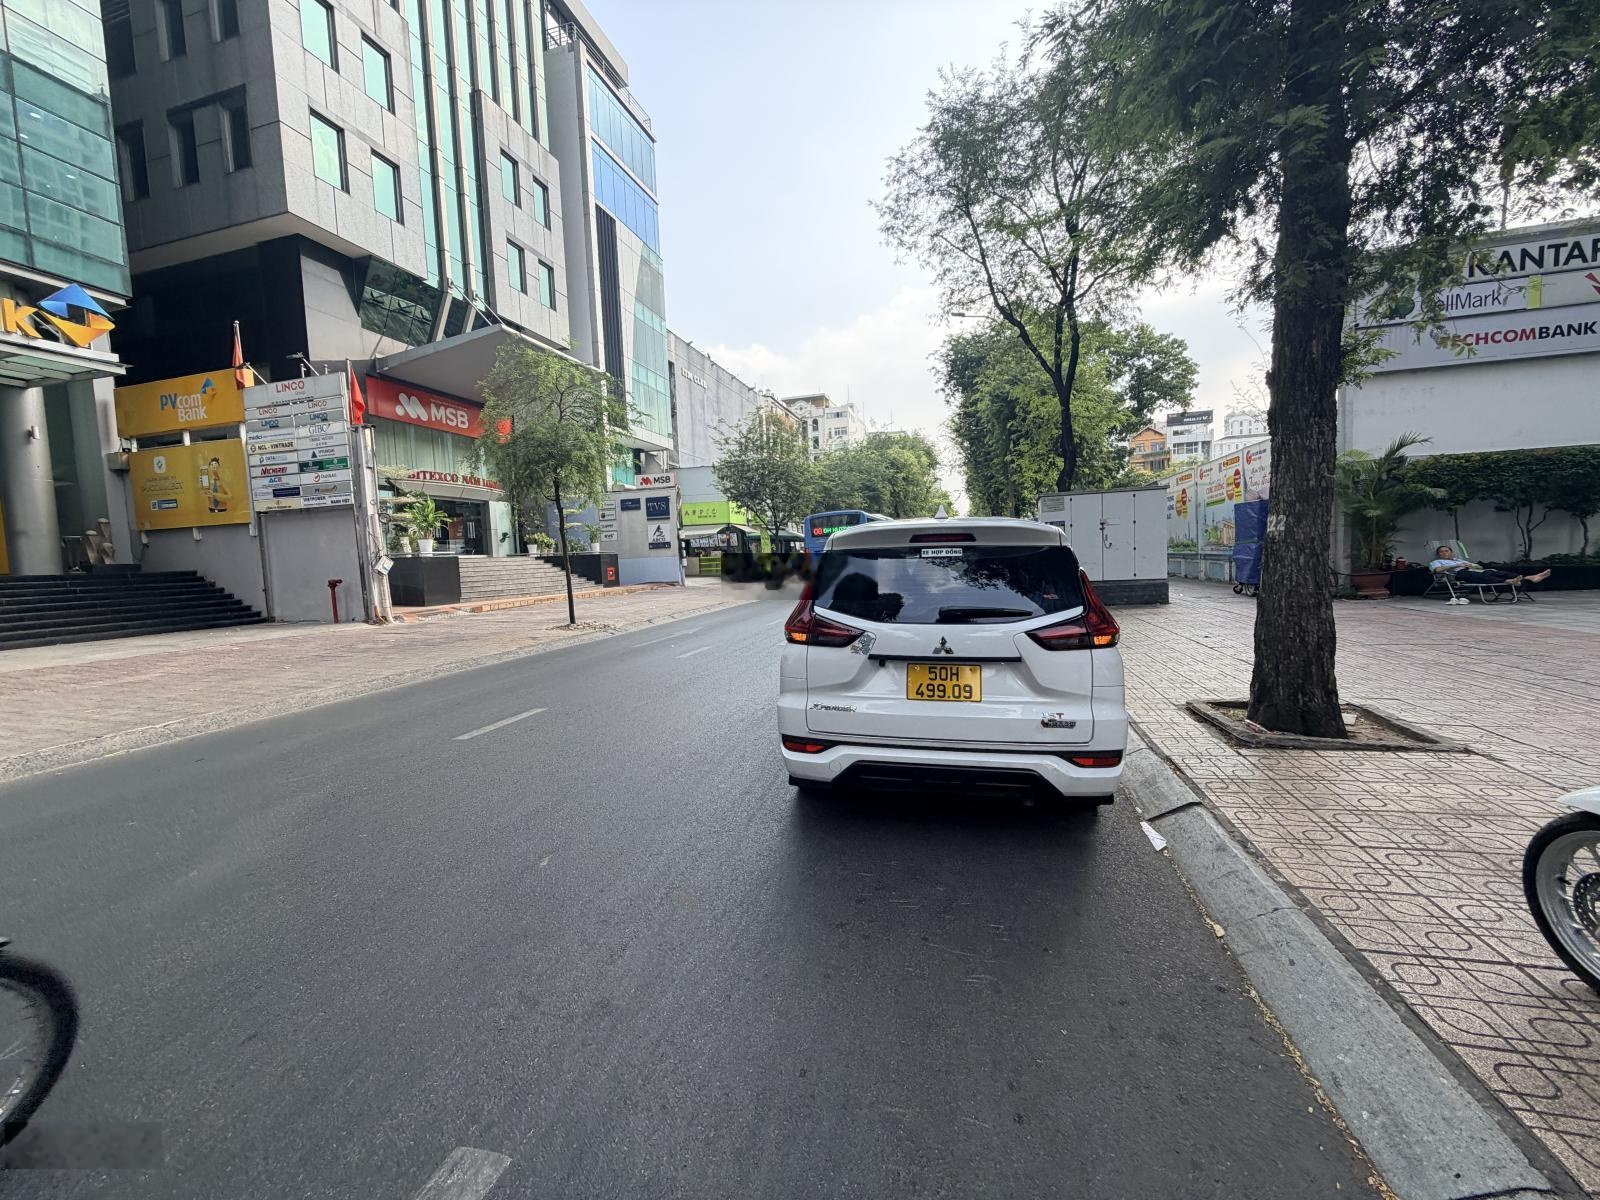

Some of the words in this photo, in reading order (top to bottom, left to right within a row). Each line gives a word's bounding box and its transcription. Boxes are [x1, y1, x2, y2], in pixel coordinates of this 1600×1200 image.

[1421, 289, 1502, 313] ellMark
[1440, 321, 1598, 346] CHCOMBANK
[276, 380, 305, 393] LINCO
[160, 393, 201, 410] PVcom
[307, 400, 327, 408] LINCO
[178, 406, 208, 422] Bank
[259, 407, 278, 415] LINCO
[431, 403, 468, 429] MSB
[654, 476, 671, 485] MSB
[928, 666, 959, 682] 50H
[915, 683, 973, 700] 499.09
